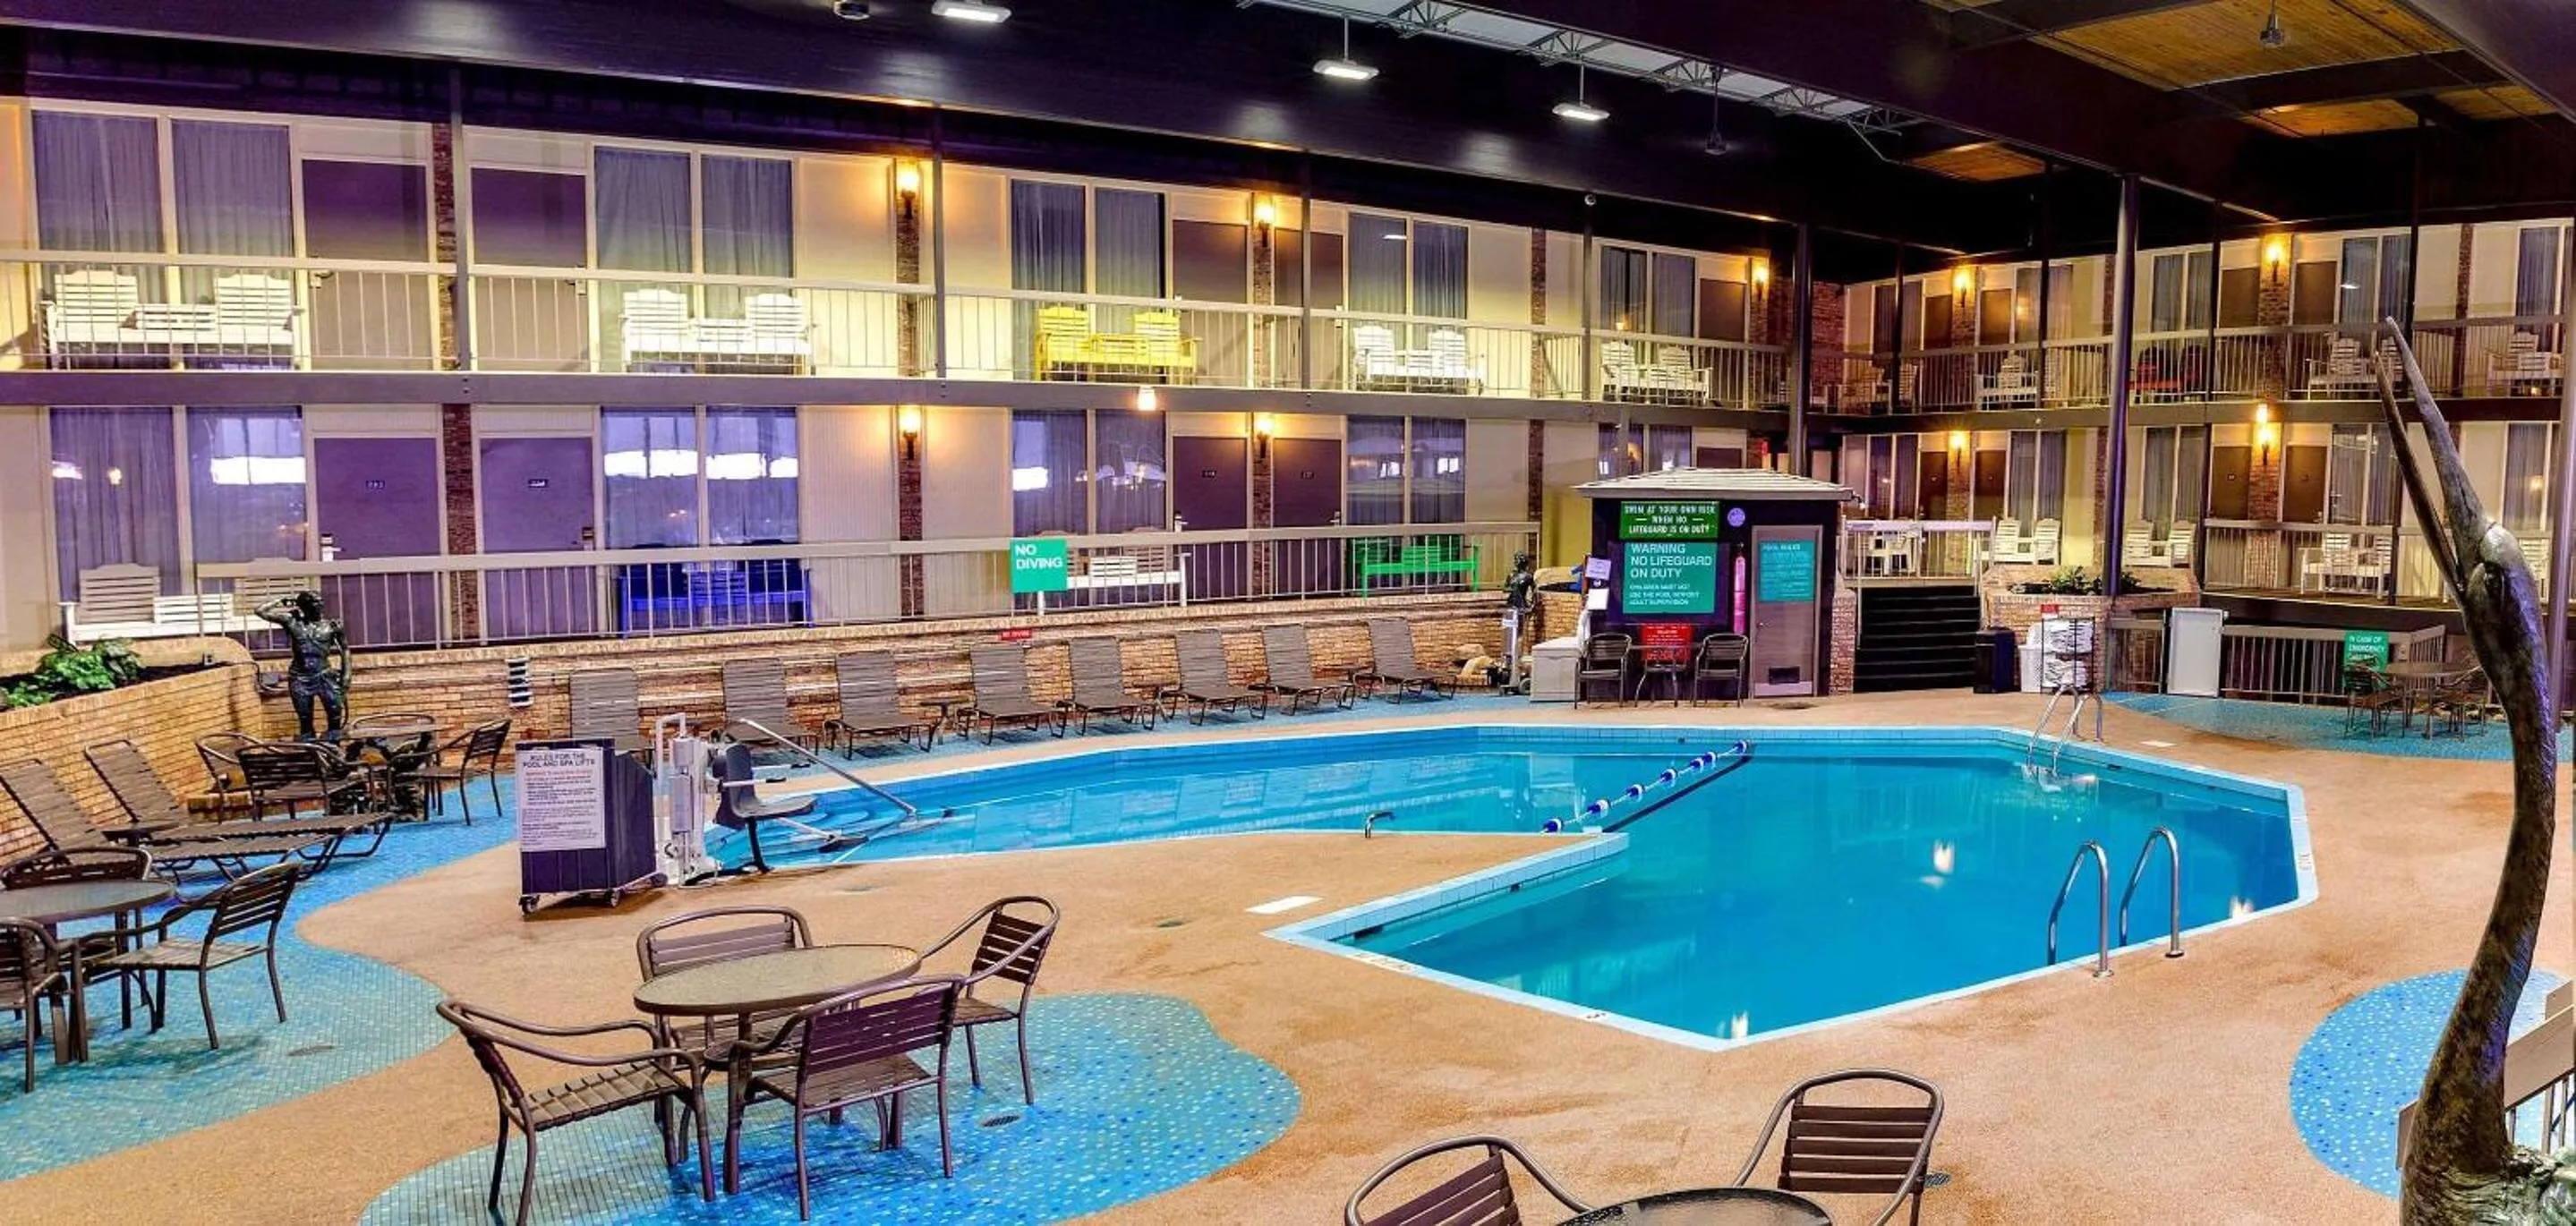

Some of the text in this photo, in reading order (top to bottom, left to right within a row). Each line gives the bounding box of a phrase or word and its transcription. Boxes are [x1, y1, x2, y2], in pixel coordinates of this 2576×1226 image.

[1629, 525, 1668, 533] LIFEGUARD
[1679, 525, 1690, 533] ON
[1015, 544, 1036, 555] NO
[1631, 543, 1686, 554] WARNING
[1016, 558, 1062, 569] DIVING
[1631, 556, 1712, 566] NO LIFEGUARD
[1631, 568, 1683, 578] ON DUTY
[575, 758, 595, 766] LIFTS
